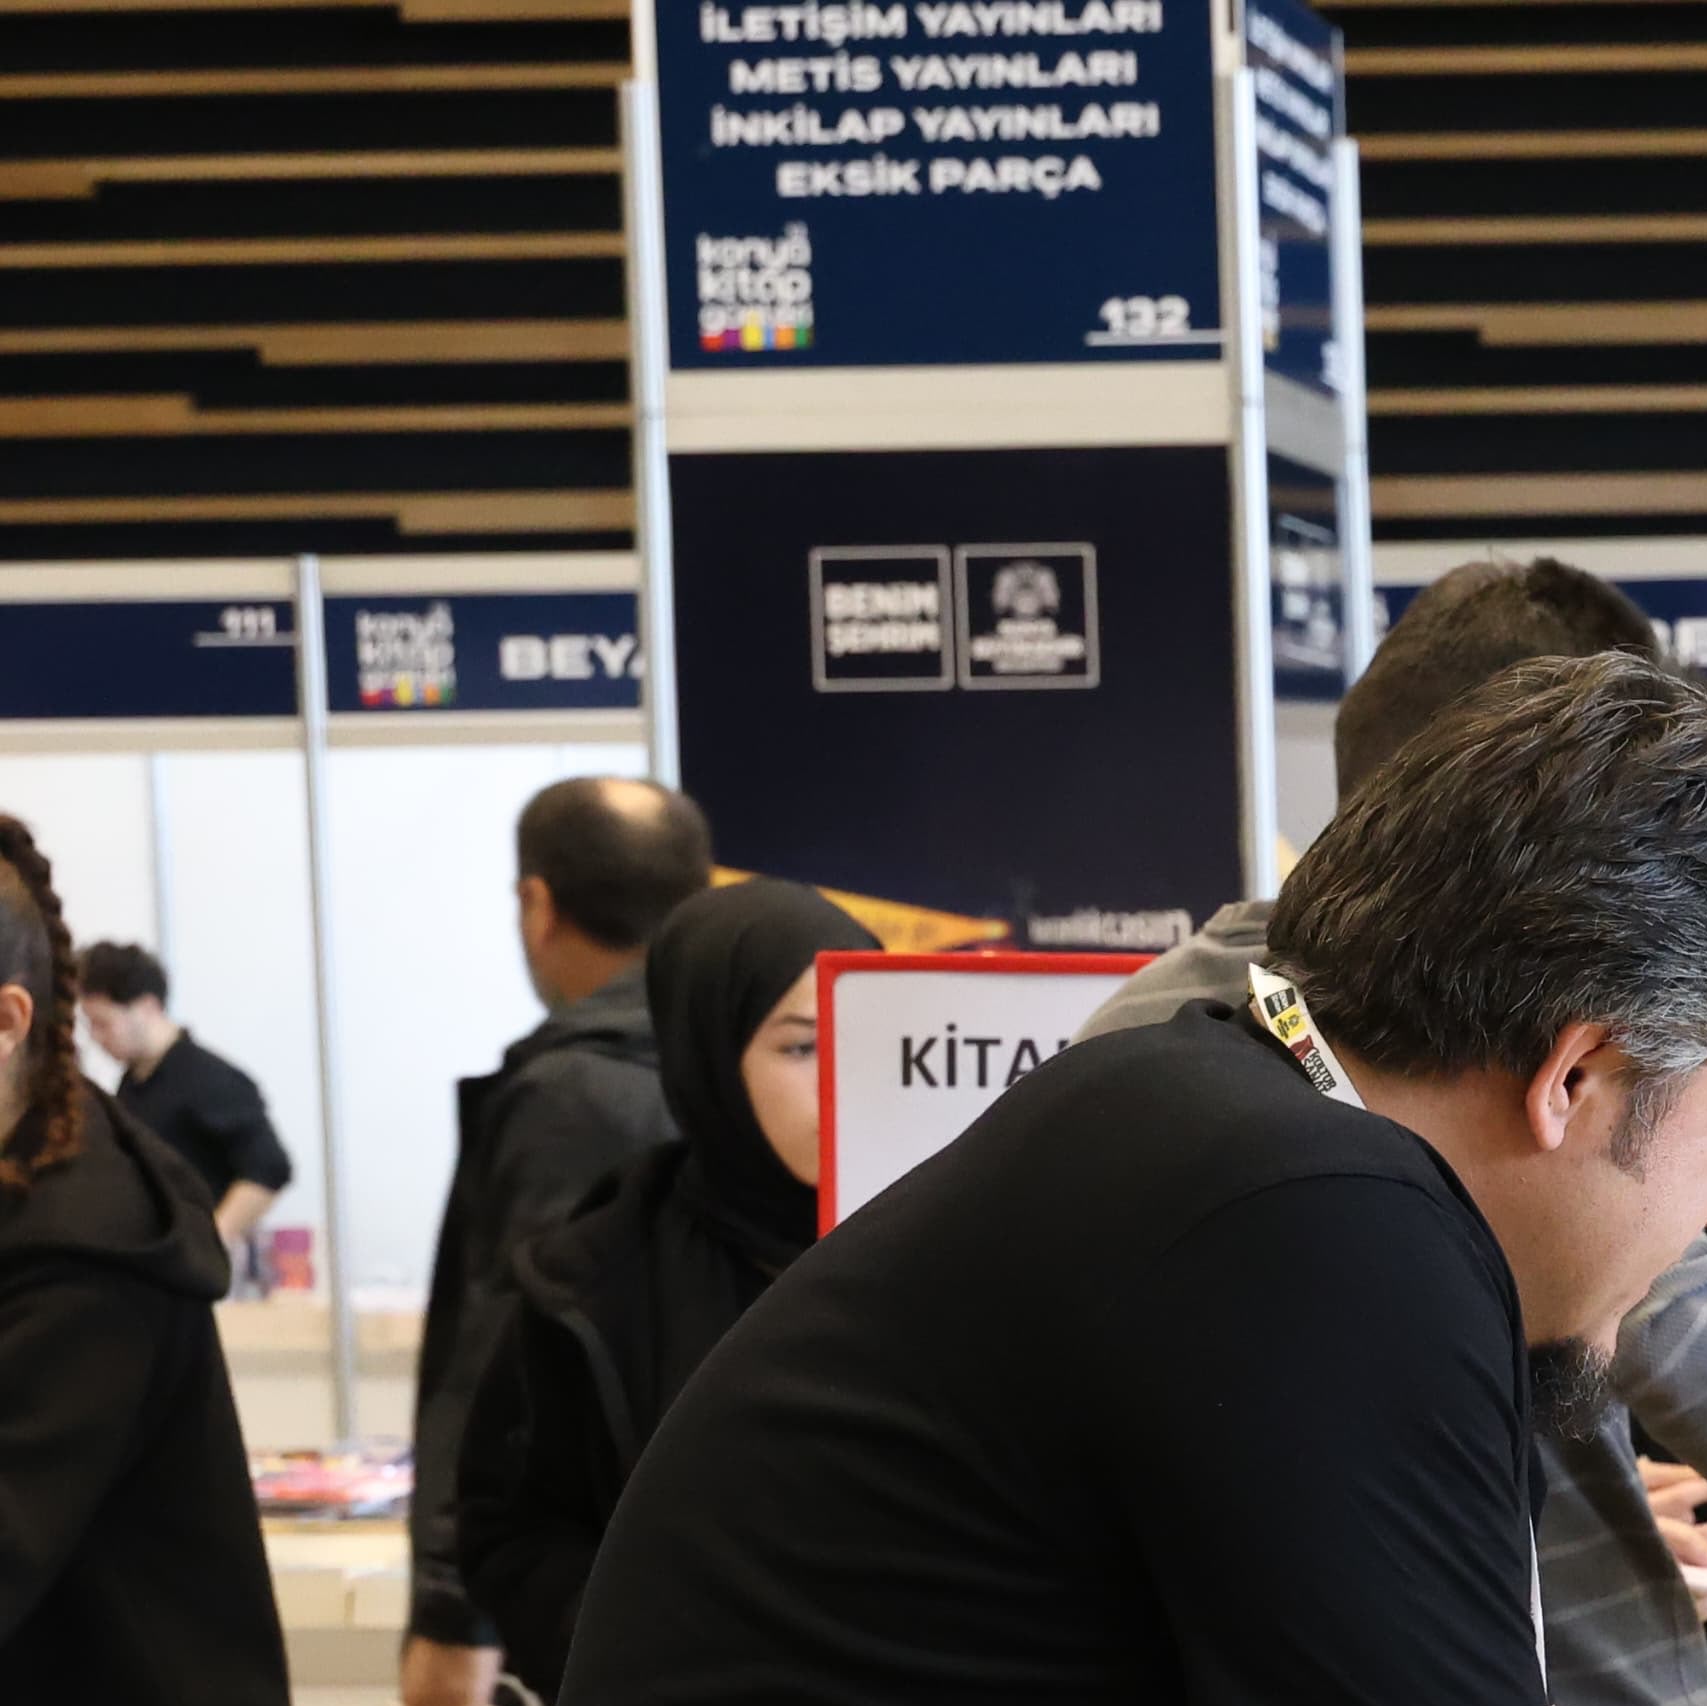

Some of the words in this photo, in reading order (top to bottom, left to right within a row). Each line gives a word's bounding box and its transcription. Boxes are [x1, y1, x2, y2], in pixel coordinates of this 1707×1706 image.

[918, 0, 1163, 36] YAYINLARI
[729, 52, 882, 94] METİS
[891, 50, 1138, 90] YAYINLARI
[711, 105, 904, 147] İNKİLAP
[913, 103, 1161, 139] YAYINLARI
[776, 153, 921, 197] EKSİK
[929, 156, 1102, 199] PARÇA
[1100, 297, 1191, 336] 132
